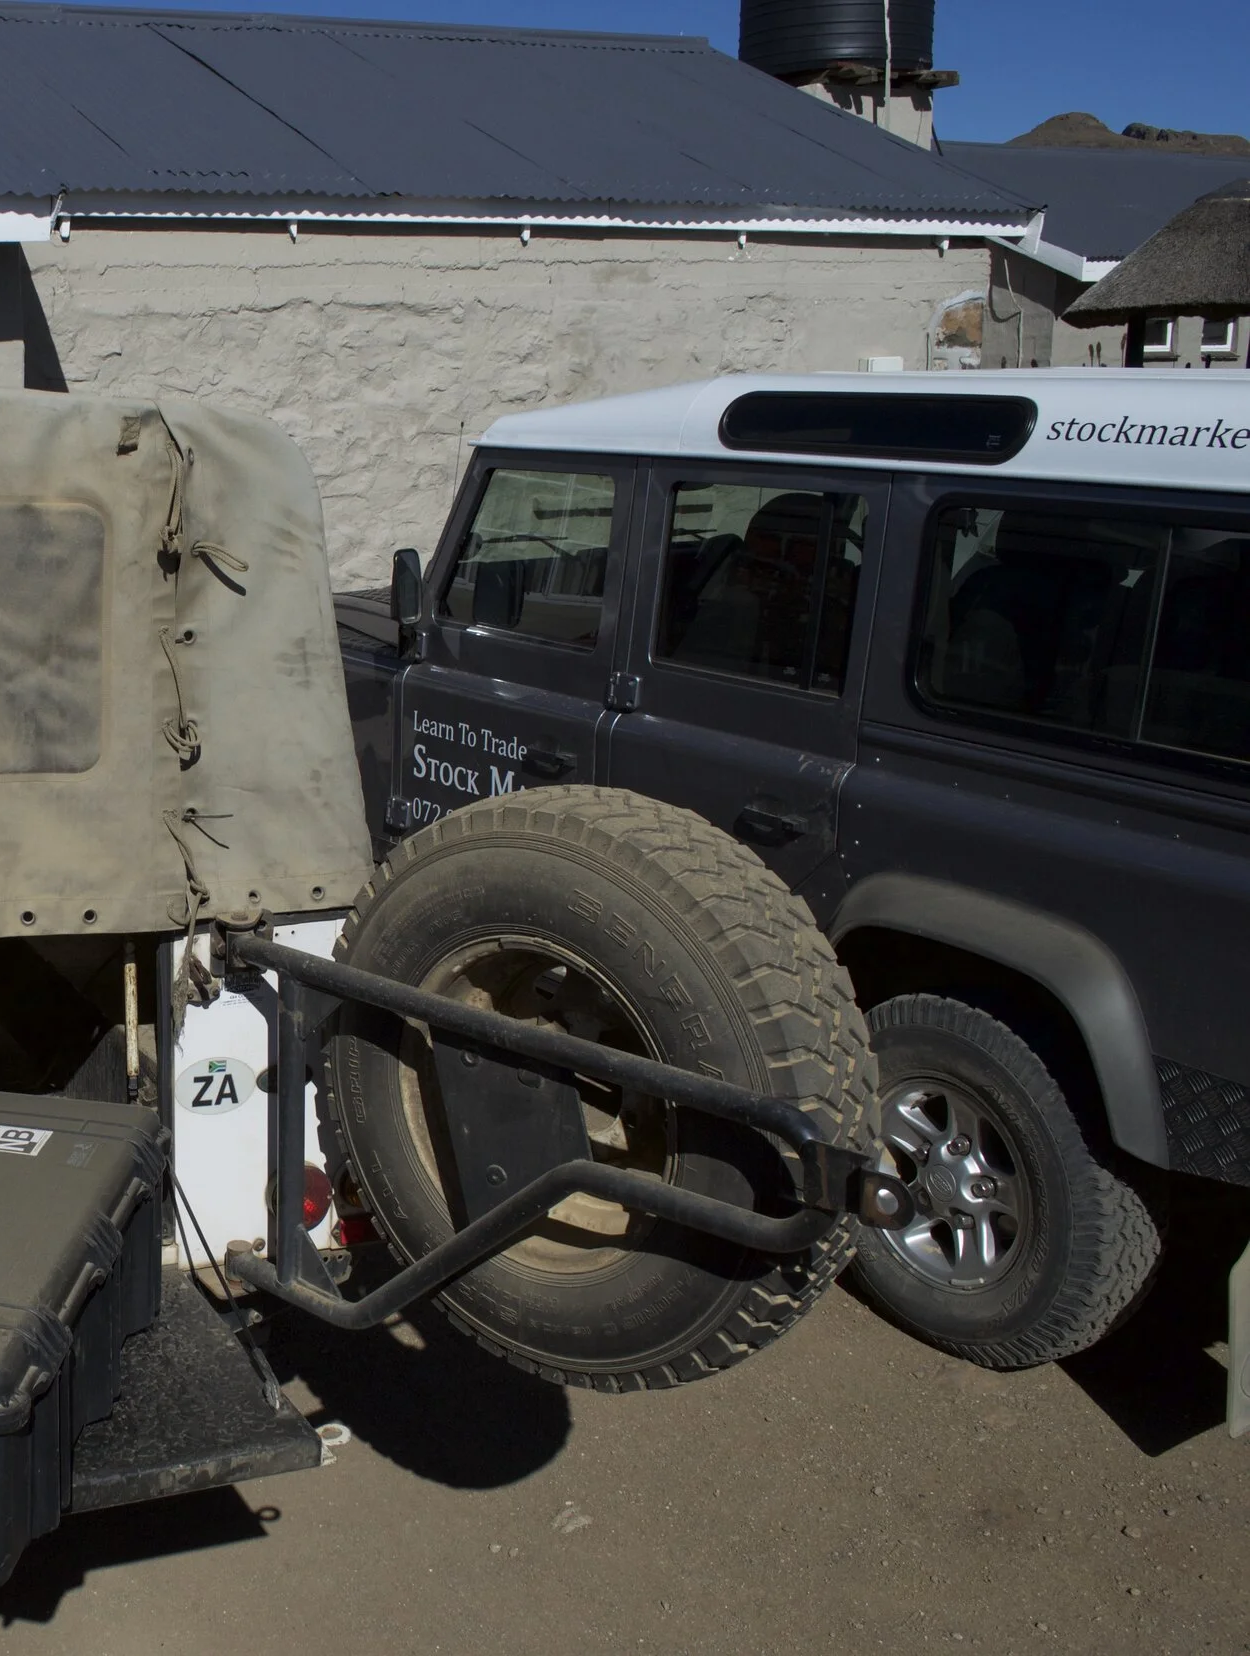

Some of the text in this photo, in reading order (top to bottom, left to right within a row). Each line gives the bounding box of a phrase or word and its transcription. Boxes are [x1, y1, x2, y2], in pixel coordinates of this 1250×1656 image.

[413, 710, 528, 761] Learn To Trade
[413, 743, 480, 796] STOCK
[191, 1073, 239, 1108] ZA
